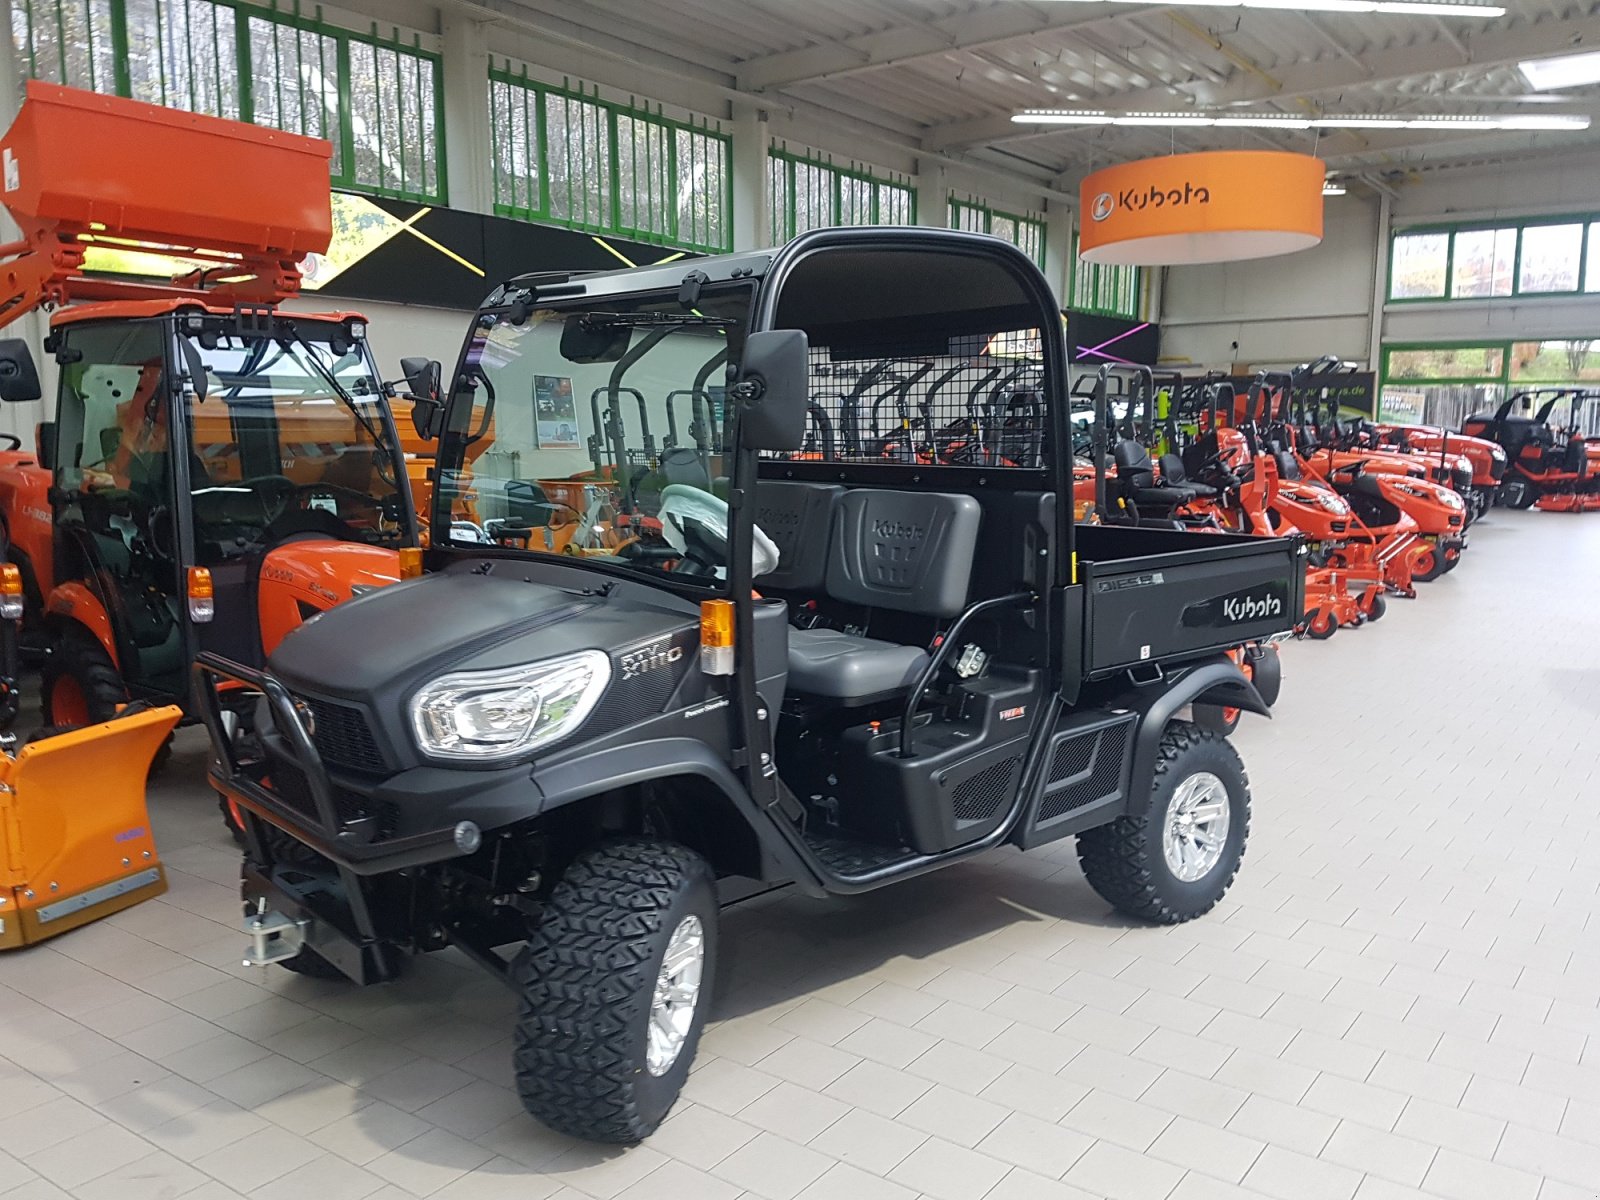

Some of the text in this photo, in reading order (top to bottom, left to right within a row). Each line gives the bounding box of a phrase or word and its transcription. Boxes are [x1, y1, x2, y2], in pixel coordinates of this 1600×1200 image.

[1119, 181, 1210, 212] Kubota
[871, 517, 924, 541] Kubota
[1223, 592, 1282, 622] Kubota
